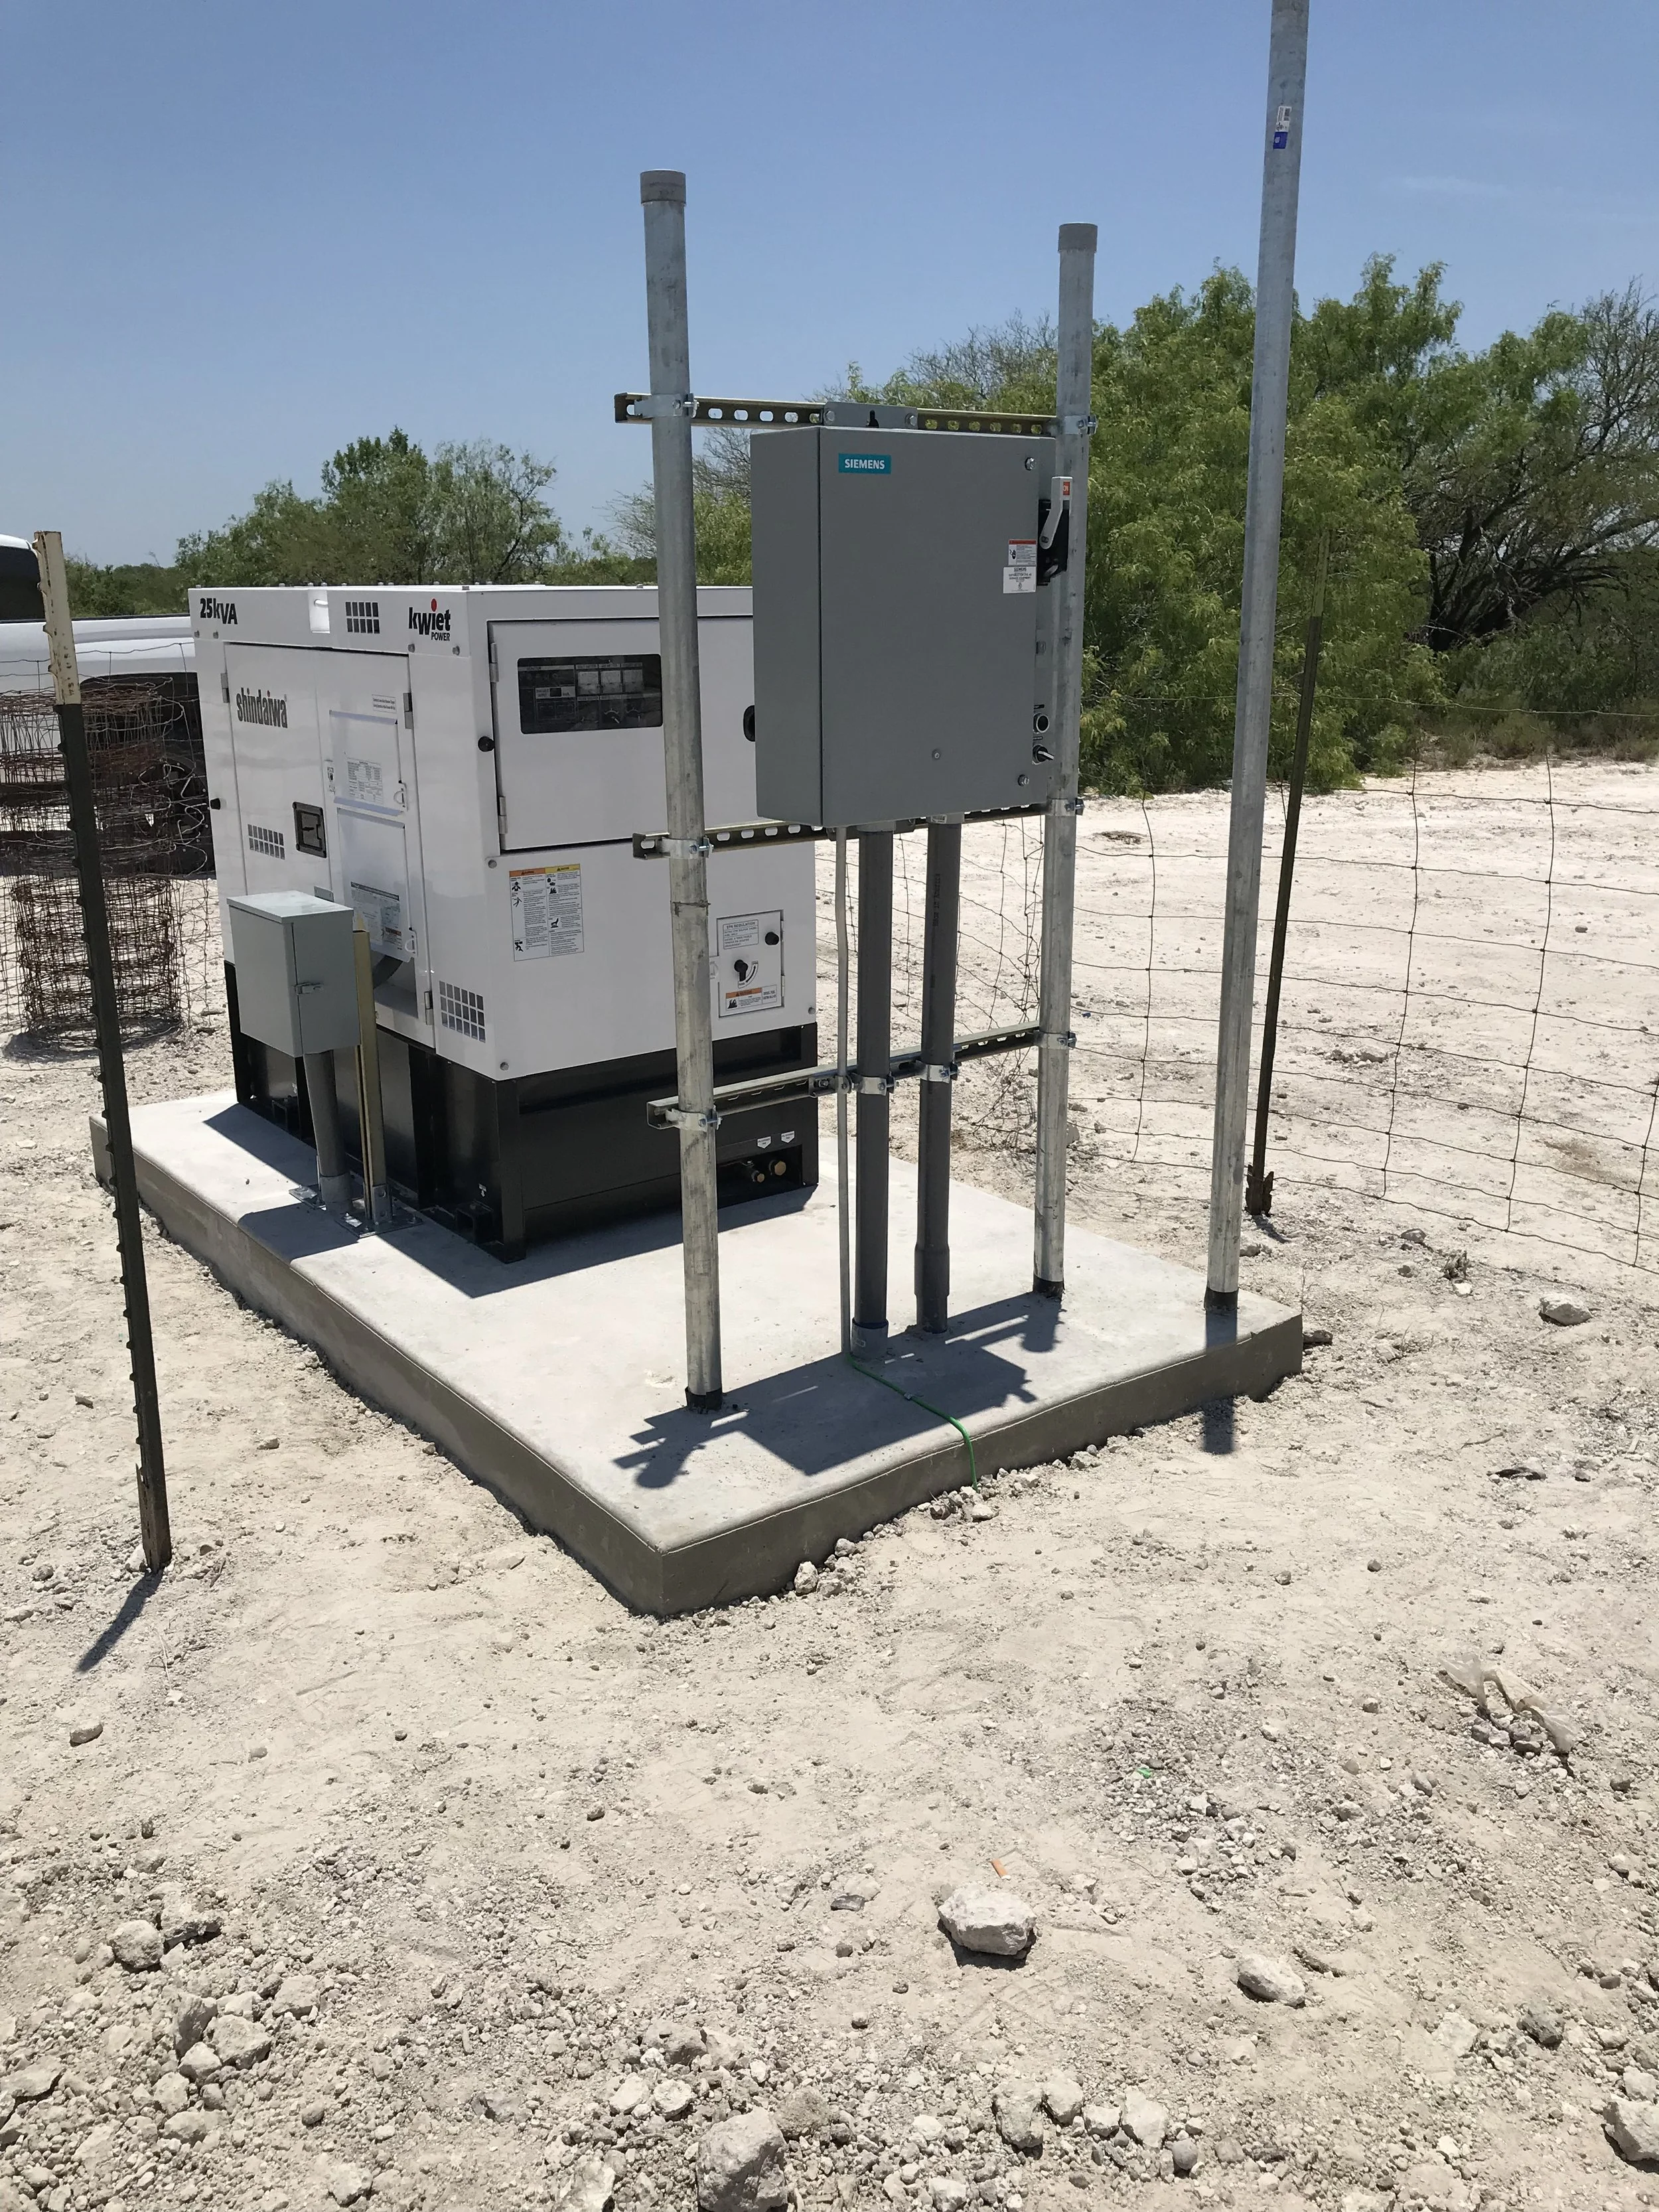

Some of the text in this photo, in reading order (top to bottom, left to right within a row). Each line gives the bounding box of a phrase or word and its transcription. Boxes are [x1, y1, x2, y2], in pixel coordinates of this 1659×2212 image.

[844, 459, 885, 470] SIEMENS
[200, 597, 238, 625] 25kVA
[409, 598, 451, 635] kwiet
[431, 632, 451, 641] POWER
[236, 687, 288, 729] shindaiwa
